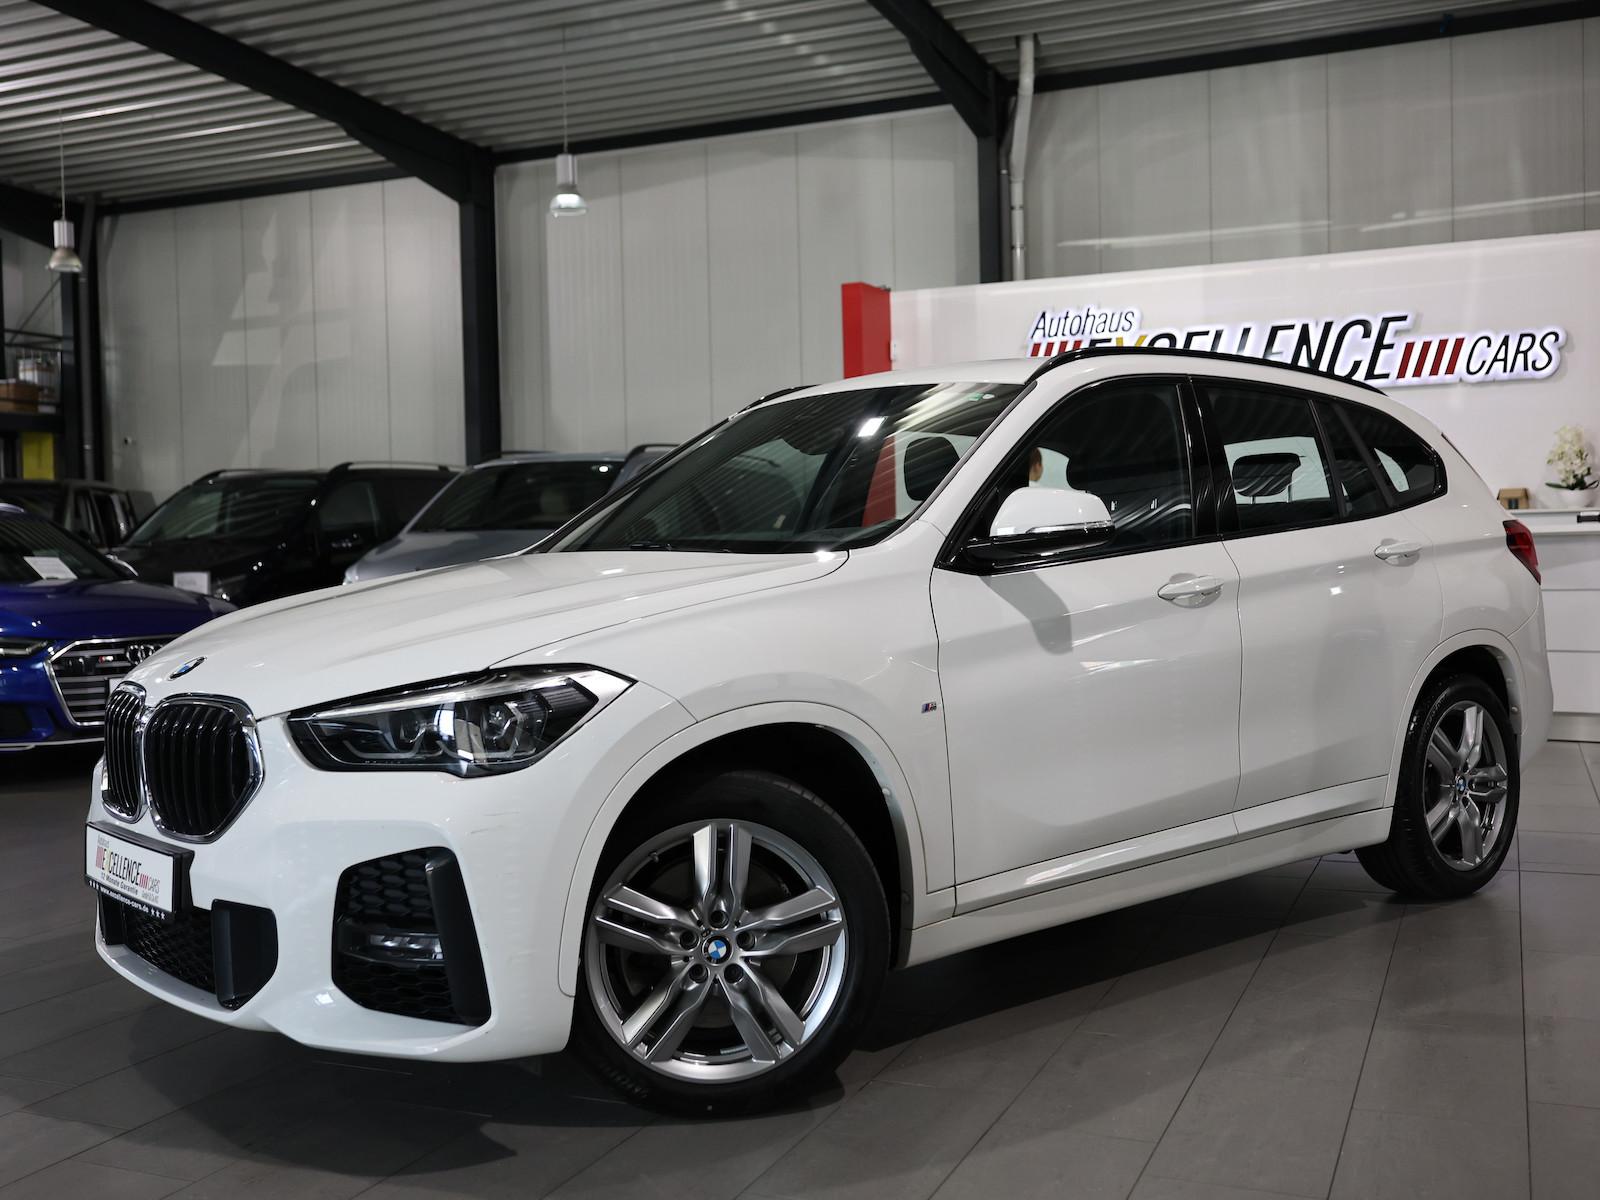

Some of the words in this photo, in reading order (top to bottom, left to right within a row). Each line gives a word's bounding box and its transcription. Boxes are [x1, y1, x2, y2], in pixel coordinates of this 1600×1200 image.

[1031, 307, 1135, 340] Autohaus
[1466, 331, 1559, 375] CARS
[102, 848, 141, 885] ECELLENCE
